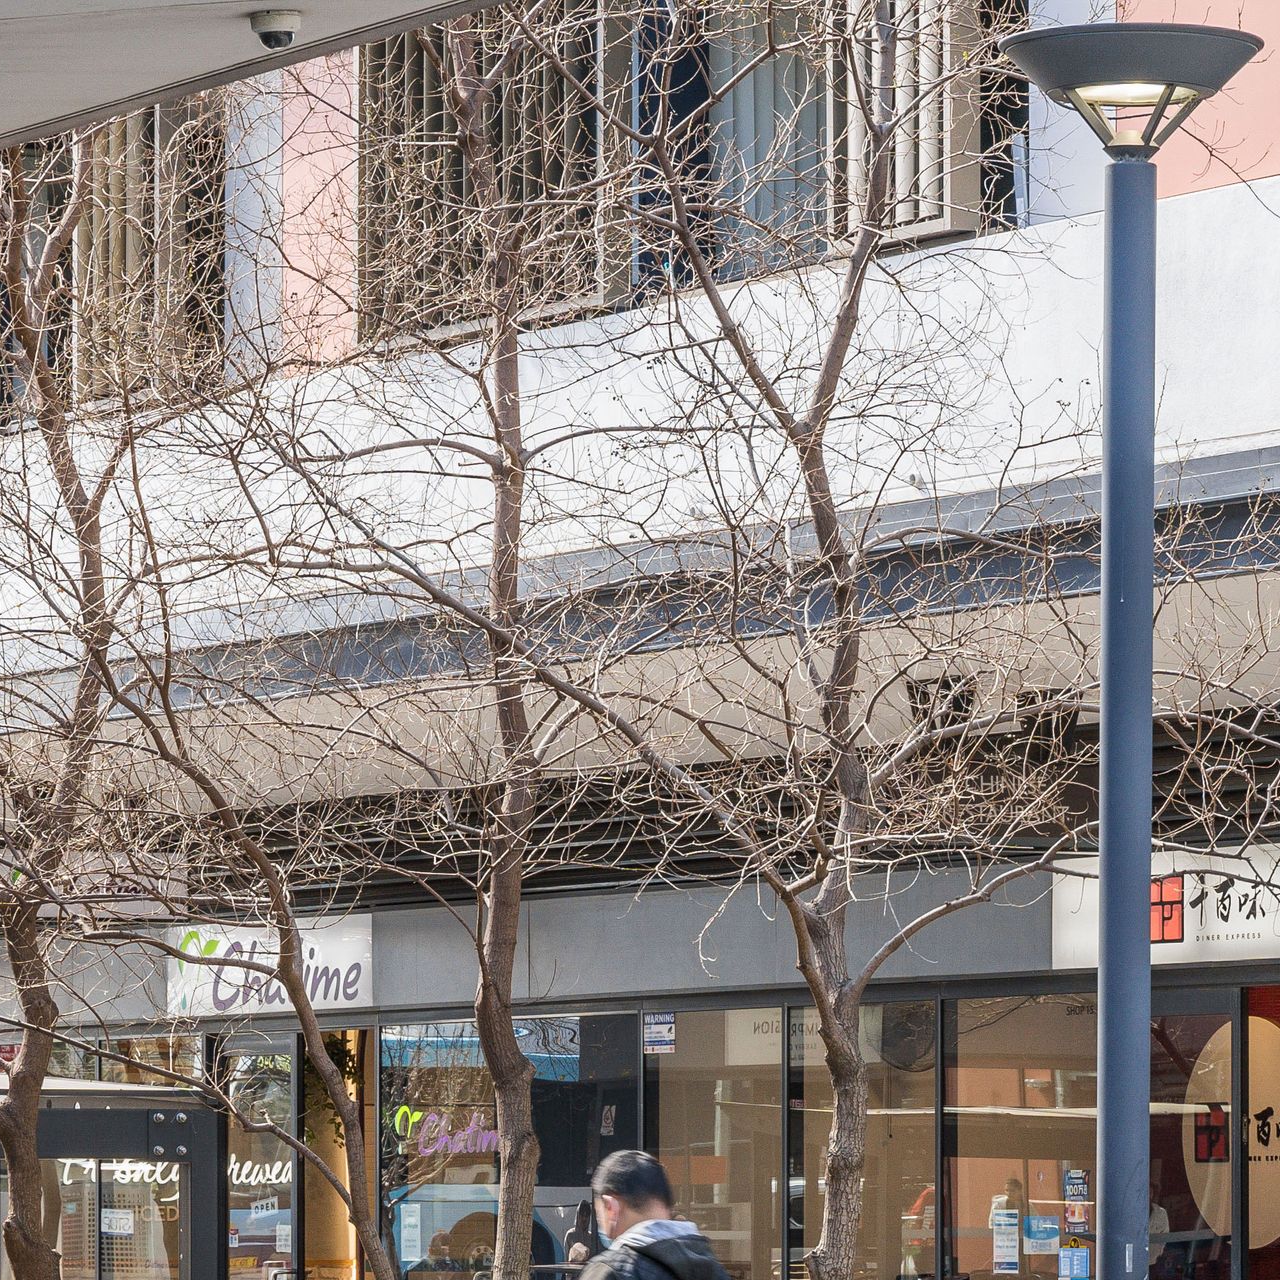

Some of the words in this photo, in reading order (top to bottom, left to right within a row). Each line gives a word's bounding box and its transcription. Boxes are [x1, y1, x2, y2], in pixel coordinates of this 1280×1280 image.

[1225, 932, 1262, 940] EXPRESS
[212, 939, 362, 1012] Chaime
[644, 1013, 675, 1024] WARNING
[419, 1112, 502, 1157] Chatim
[254, 1202, 276, 1214] OPEN
